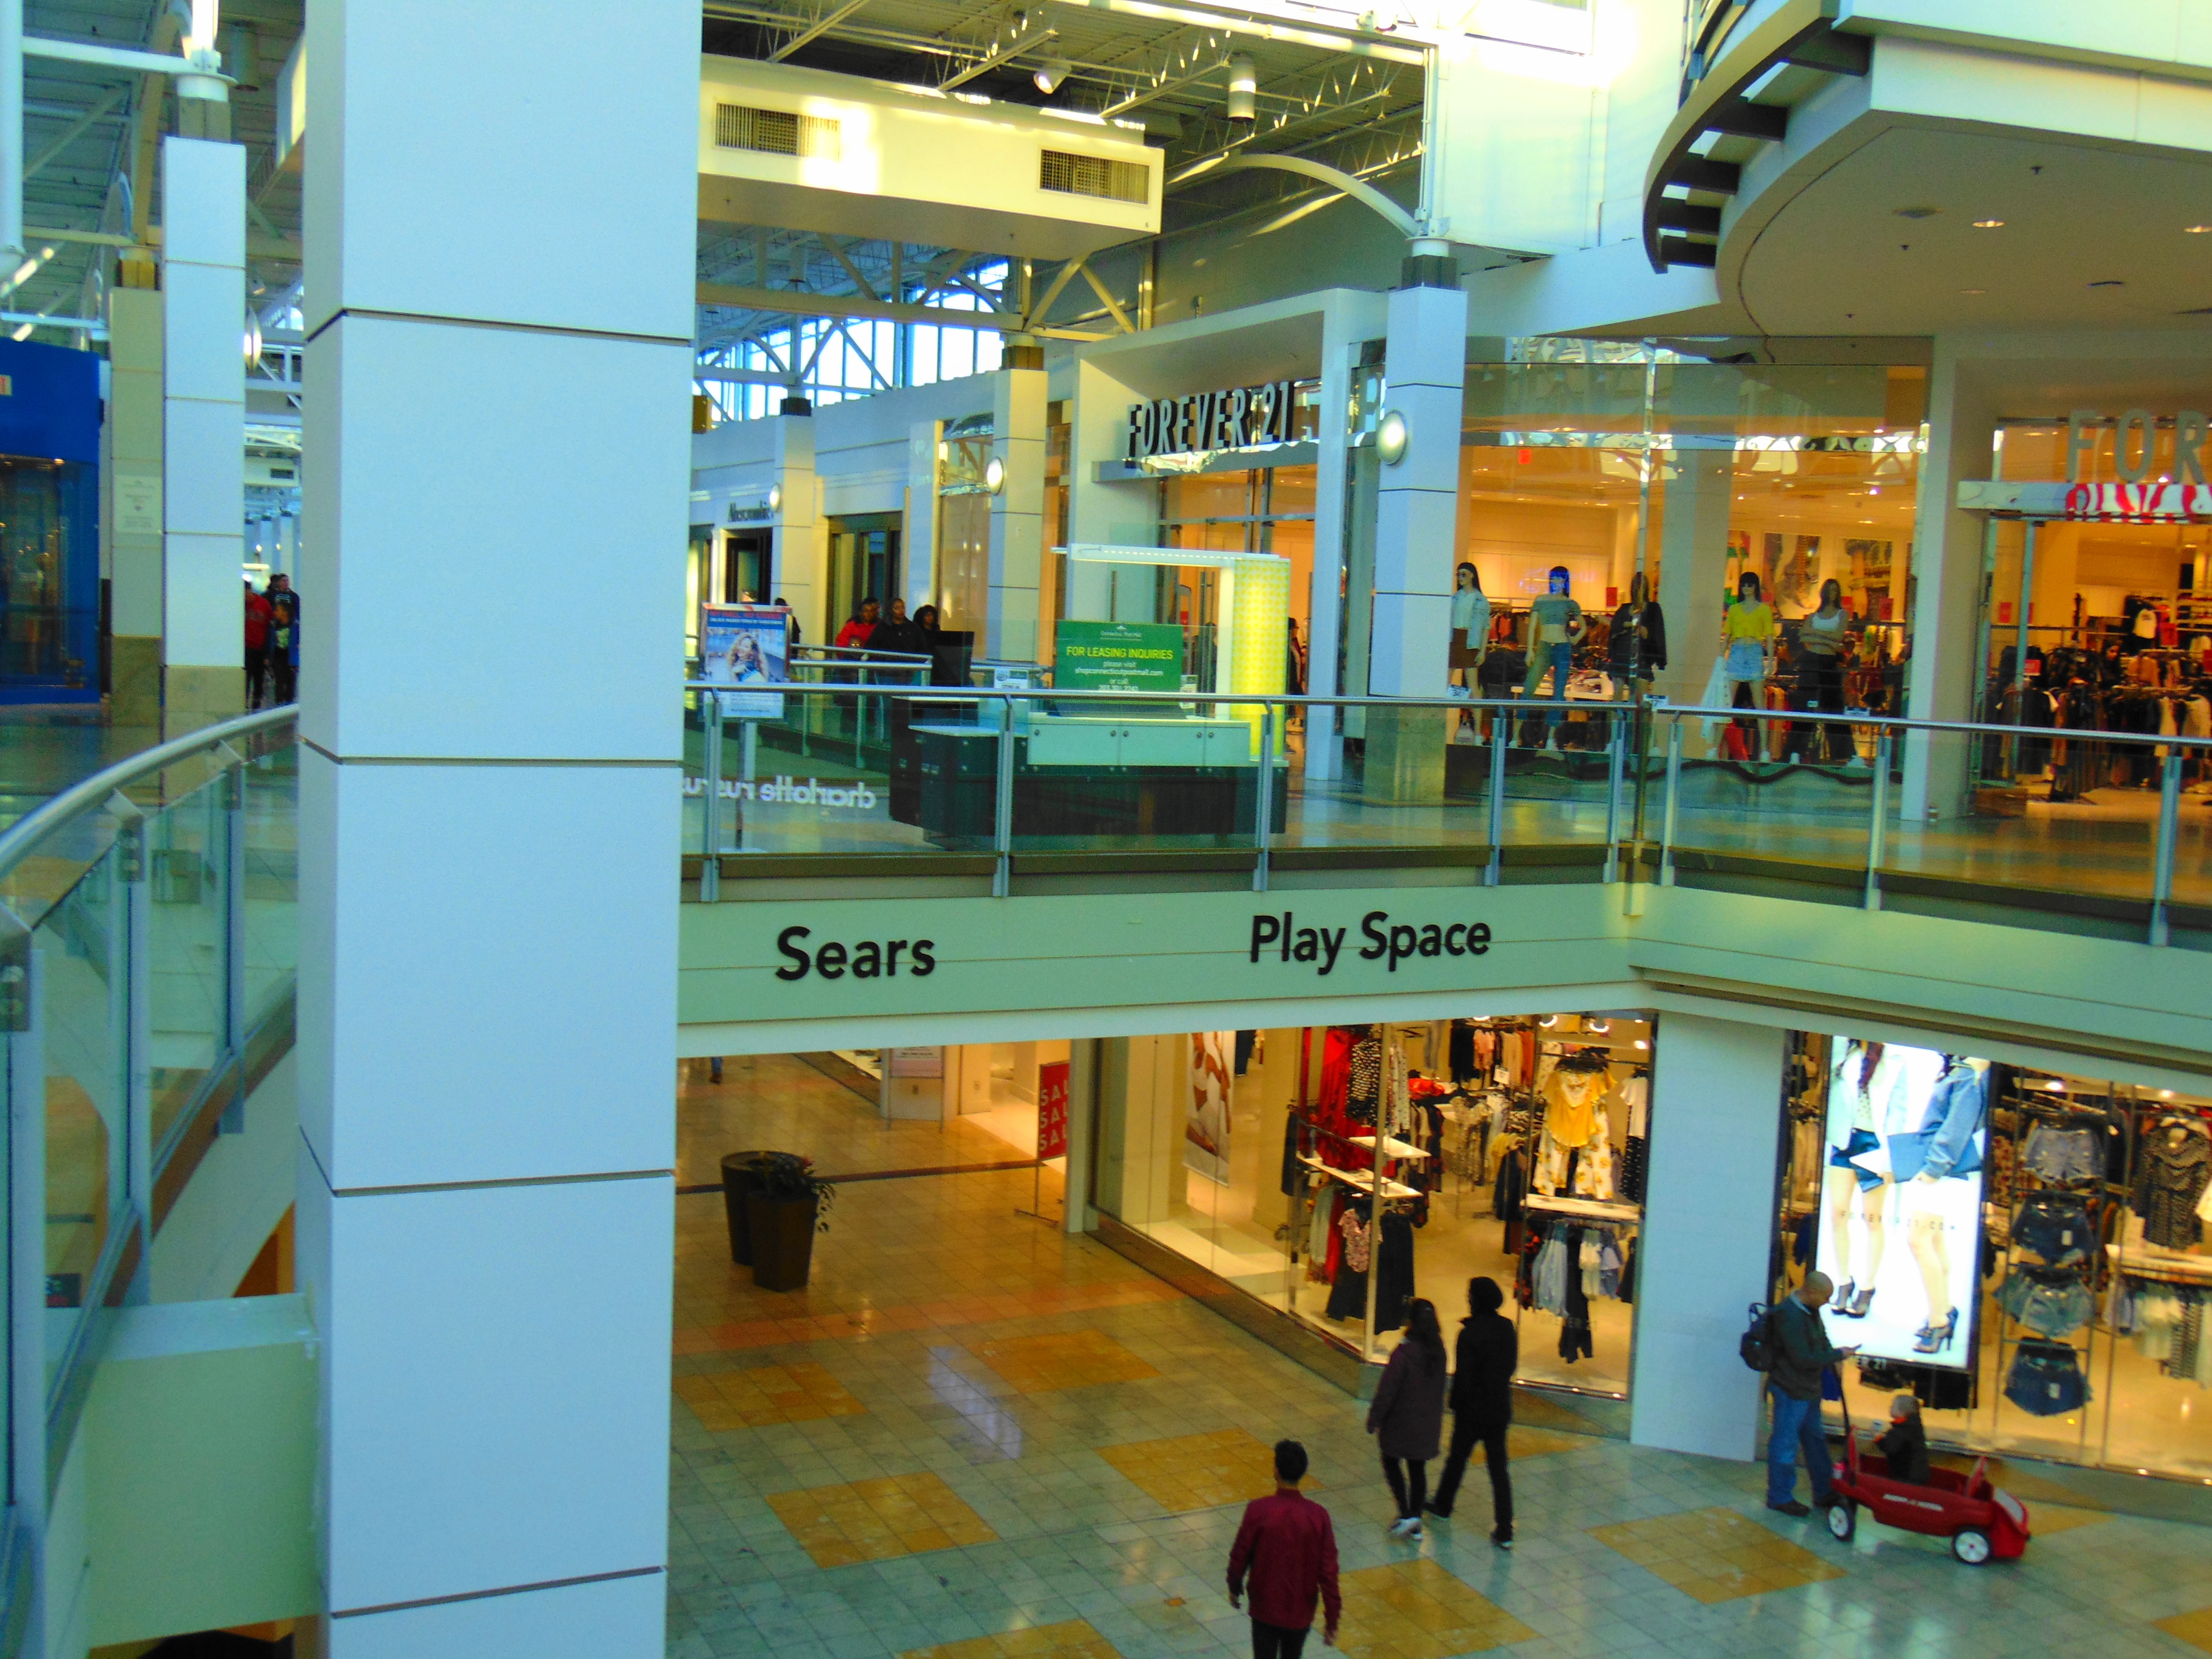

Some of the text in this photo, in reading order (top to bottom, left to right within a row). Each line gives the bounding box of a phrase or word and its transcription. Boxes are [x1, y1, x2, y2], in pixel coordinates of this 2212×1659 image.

[1127, 380, 1296, 458] FOREVER 21
[1066, 646, 1174, 660] FOR LEASING INQUIRIES
[775, 925, 936, 981] Sears
[1250, 910, 1492, 975] Play Space
